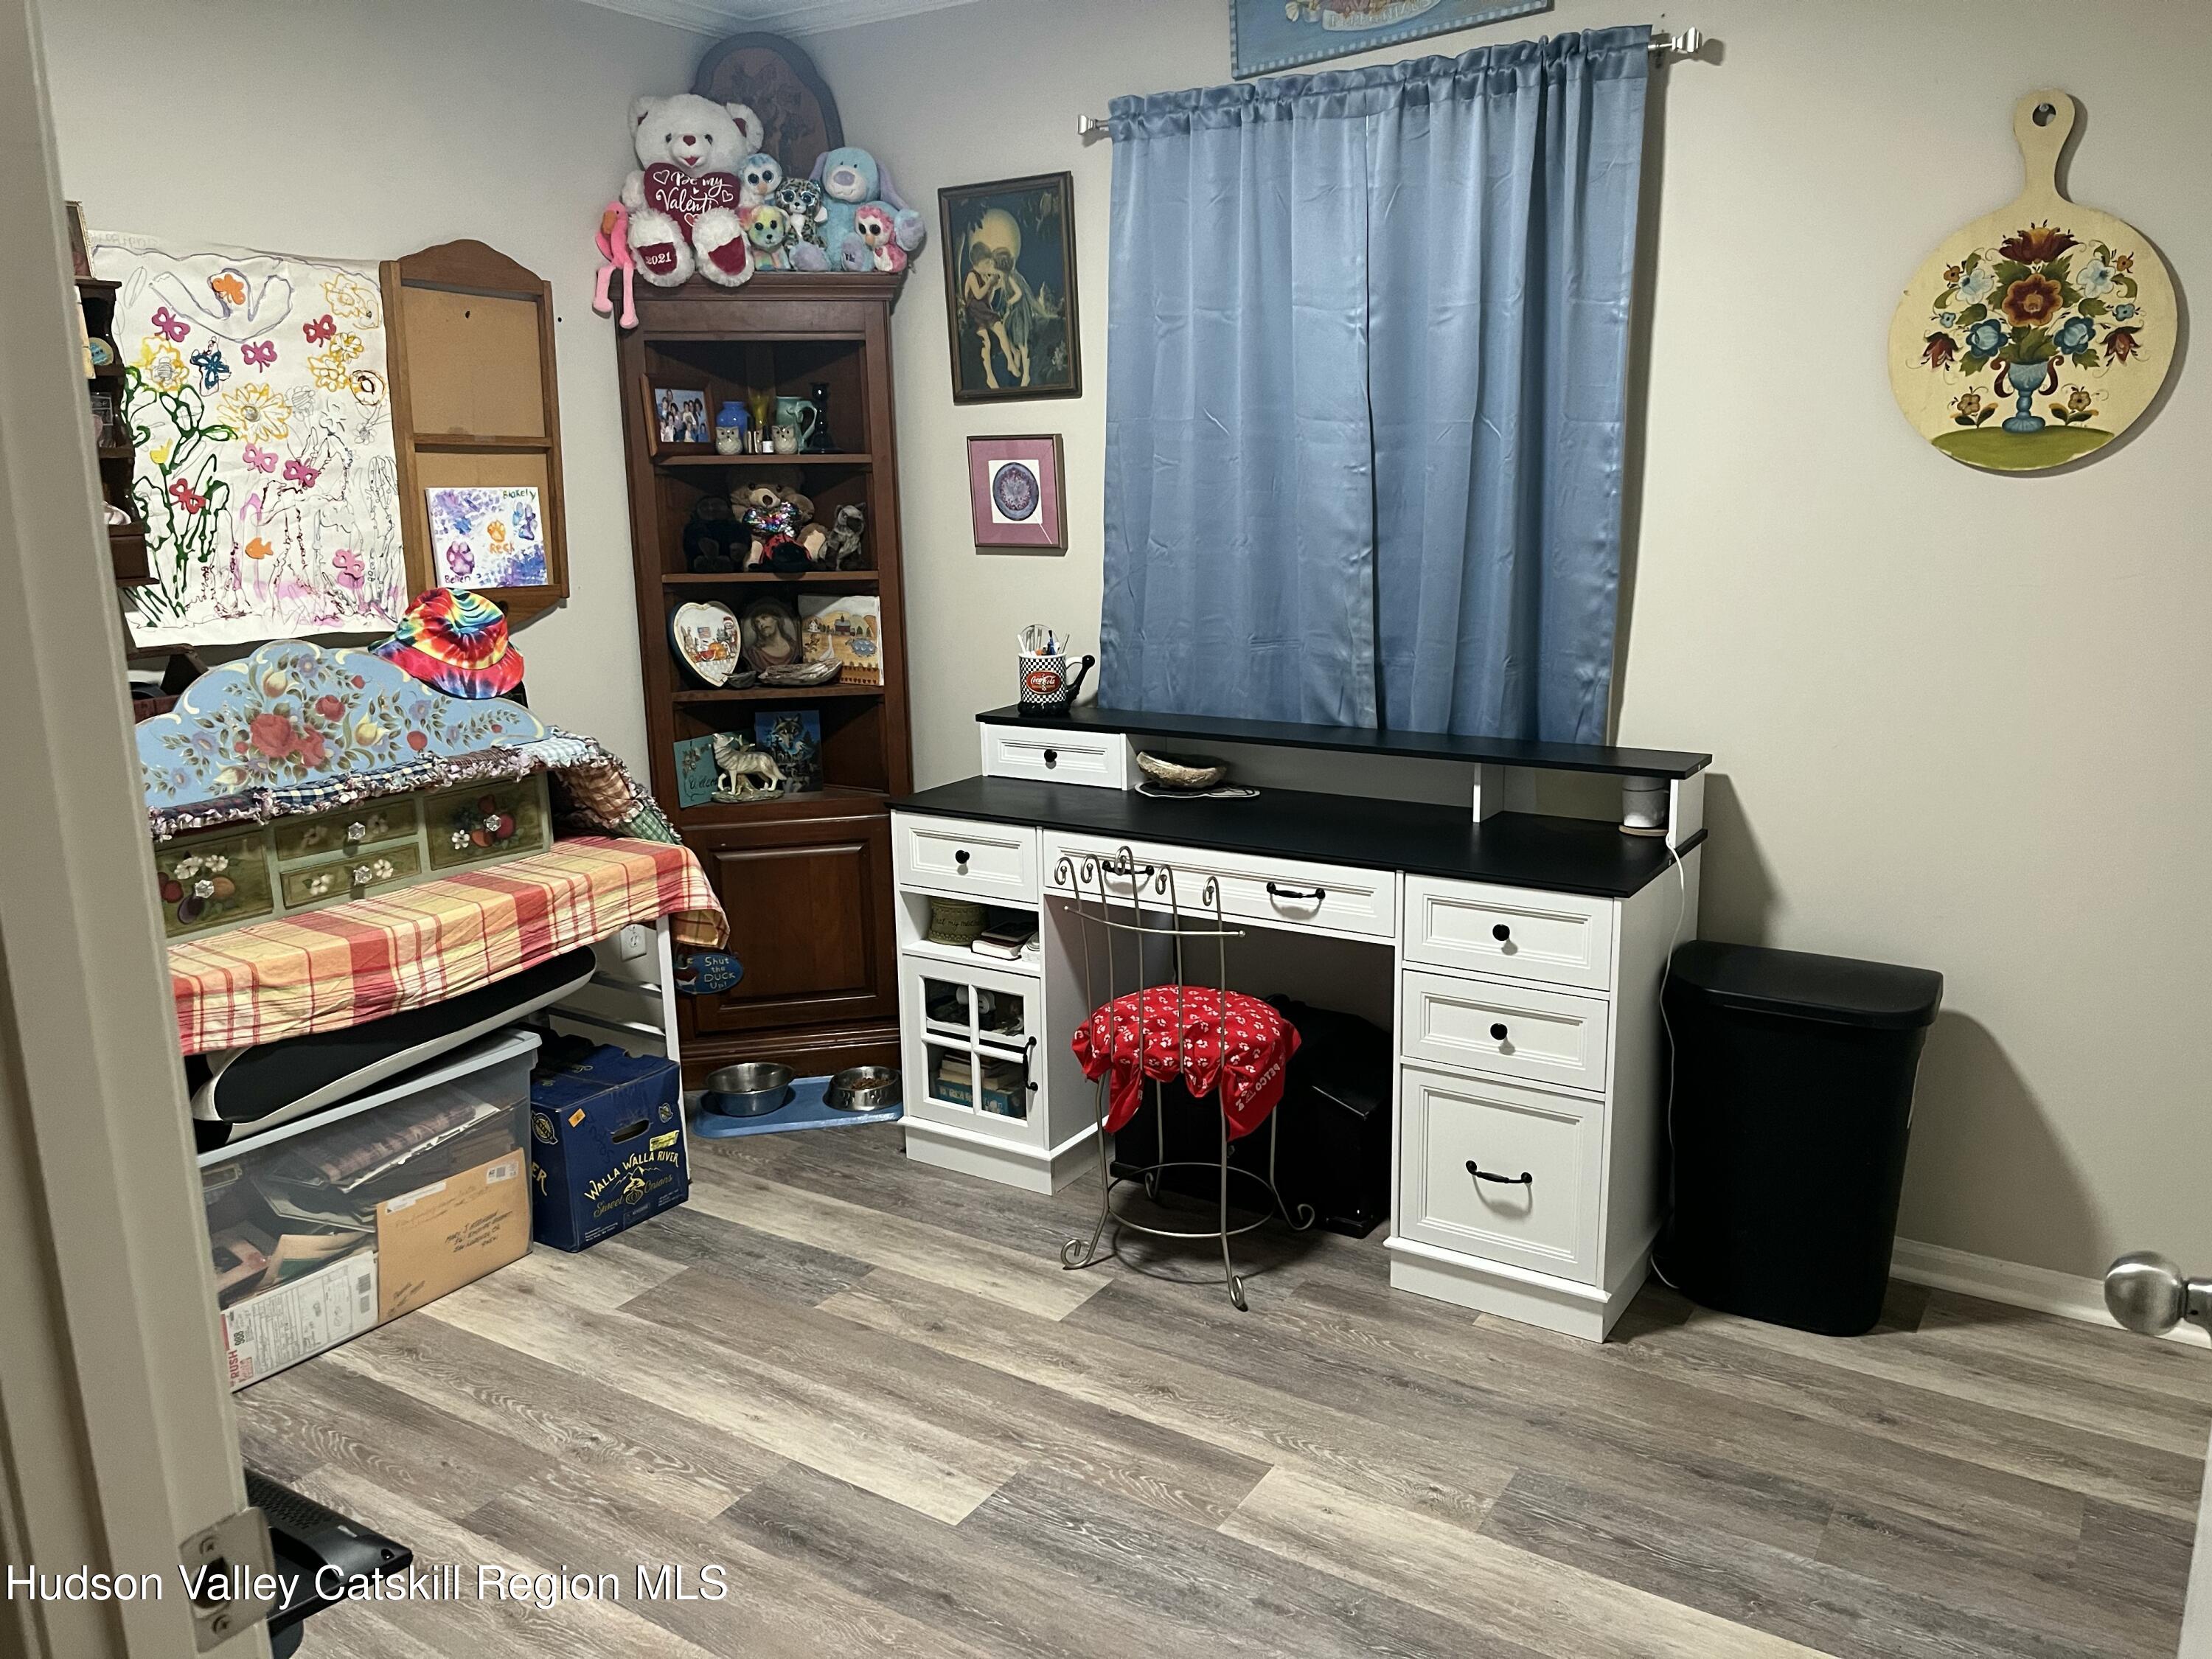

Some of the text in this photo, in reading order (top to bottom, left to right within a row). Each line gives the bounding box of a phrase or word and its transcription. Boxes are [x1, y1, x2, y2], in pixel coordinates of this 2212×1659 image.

[702, 177, 733, 197] my
[655, 187, 723, 214] Valenti
[645, 251, 672, 265] 2021
[705, 956, 729, 967] Shut
[704, 973, 736, 982] DUCK
[709, 981, 727, 989] Up!
[584, 1150, 678, 1200] WALLA WALLA RIVER
[593, 1194, 624, 1218] Sweet
[644, 1174, 672, 1193] Onions
[228, 1349, 240, 1380] RUSH
